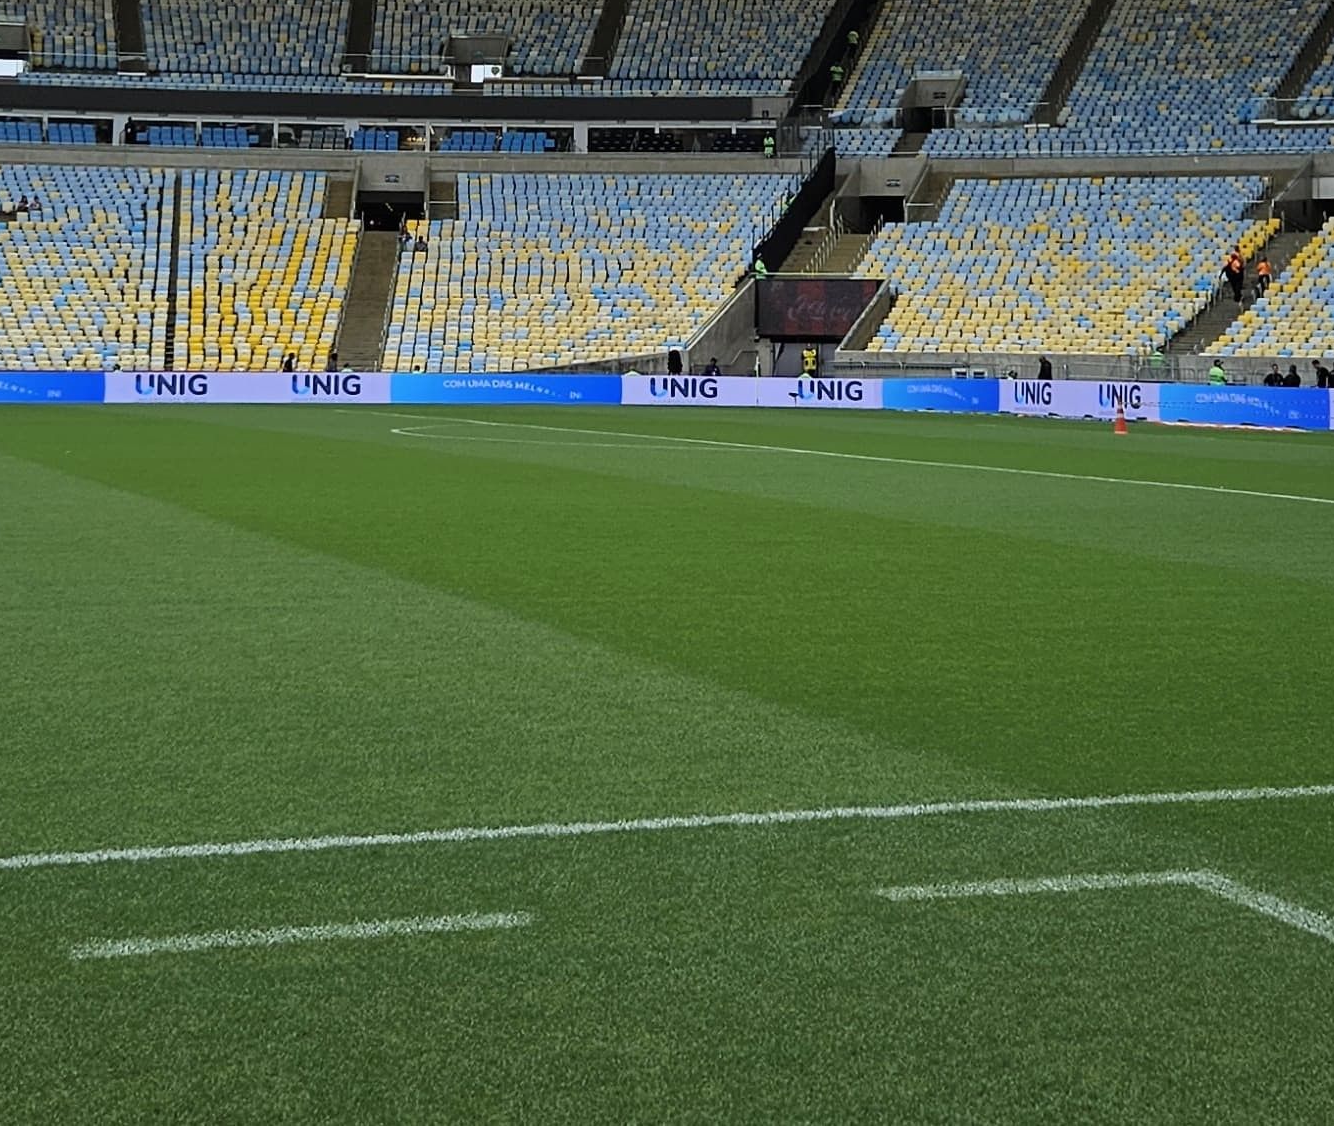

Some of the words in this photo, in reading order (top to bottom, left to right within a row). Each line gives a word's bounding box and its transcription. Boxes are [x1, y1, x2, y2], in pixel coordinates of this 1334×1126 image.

[134, 374, 208, 396] UNIG
[291, 374, 362, 396] UNIG
[650, 377, 718, 398] UNIG
[798, 380, 863, 401] UNIG
[1014, 381, 1052, 405] UNIG
[1099, 384, 1141, 409] UNIG
